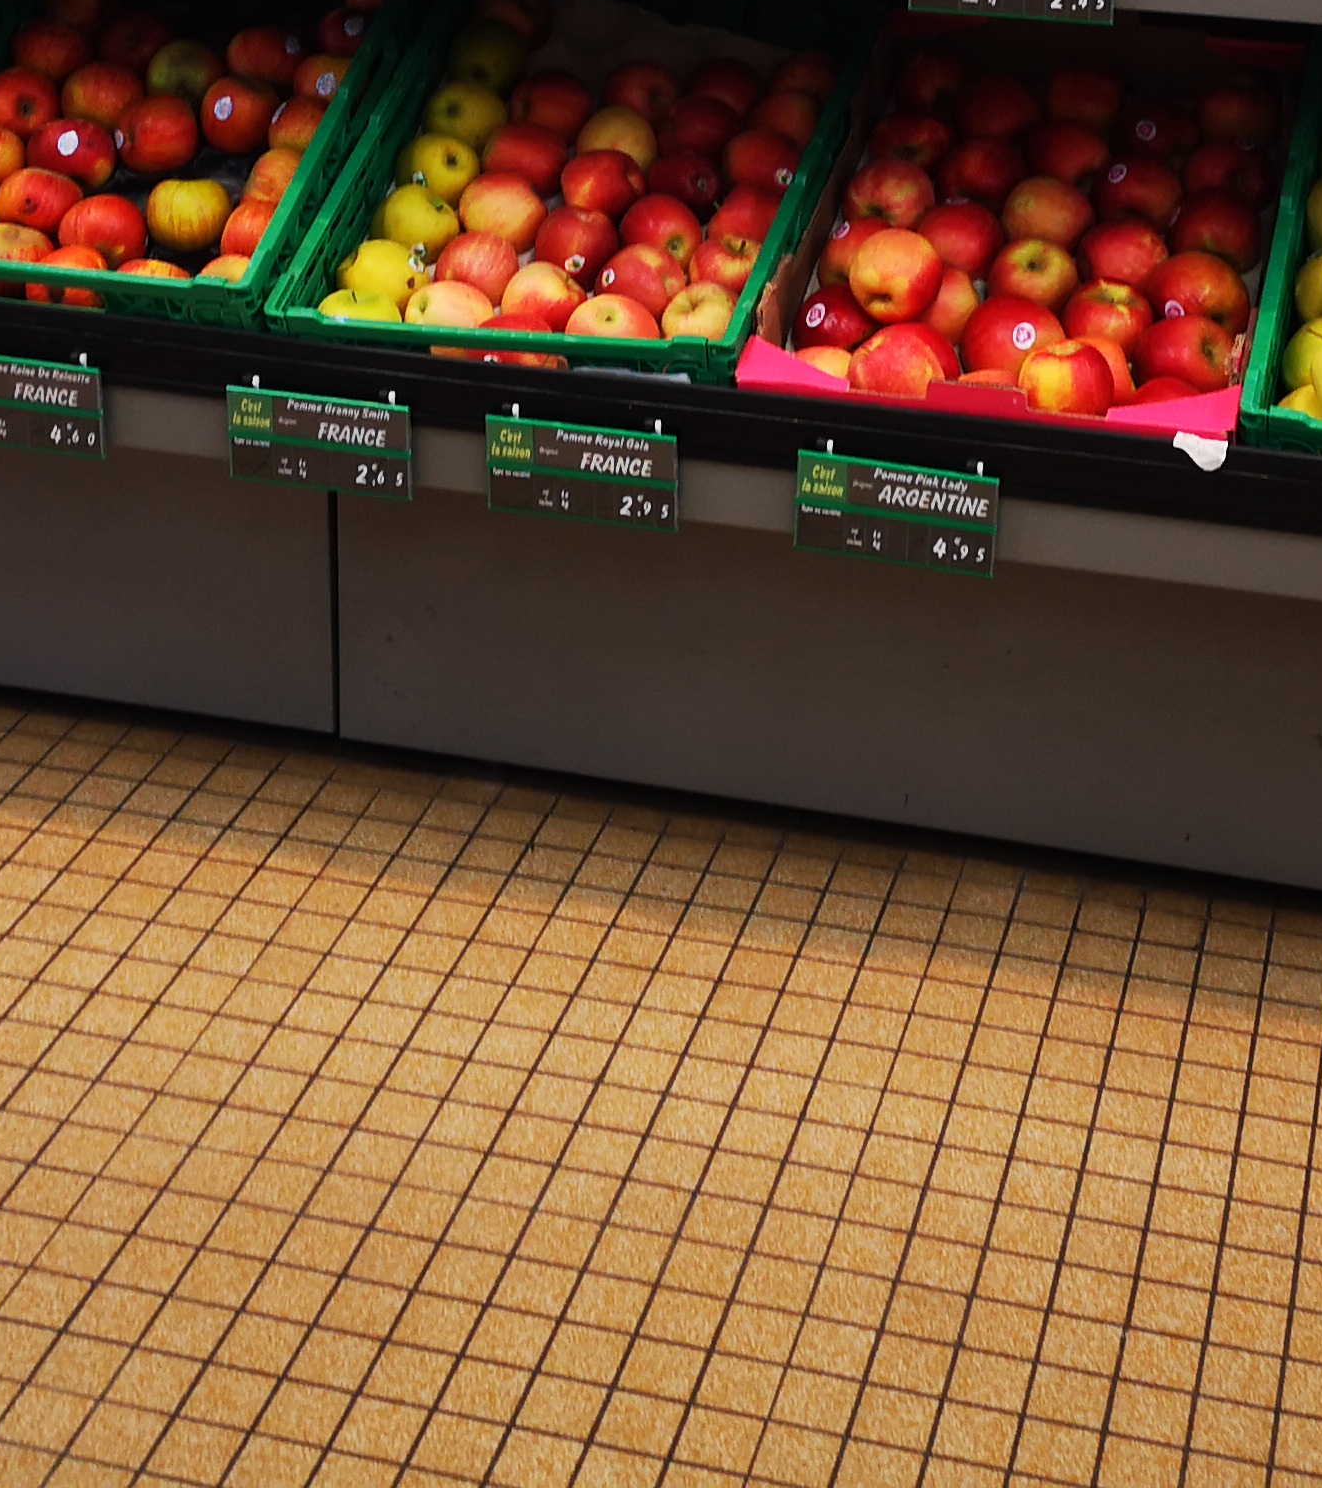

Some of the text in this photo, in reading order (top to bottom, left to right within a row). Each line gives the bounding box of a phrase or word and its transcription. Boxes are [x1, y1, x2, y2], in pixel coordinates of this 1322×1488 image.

[14, 381, 79, 408] FRANCE
[286, 398, 390, 422] Pomme Granny Smith
[318, 421, 387, 448] FRANCE
[556, 428, 650, 452] Pomme Royal Gala
[580, 451, 653, 478] FRANCE
[874, 467, 968, 493] Pomme Pink Lady
[878, 484, 990, 518] ARGENTINE
